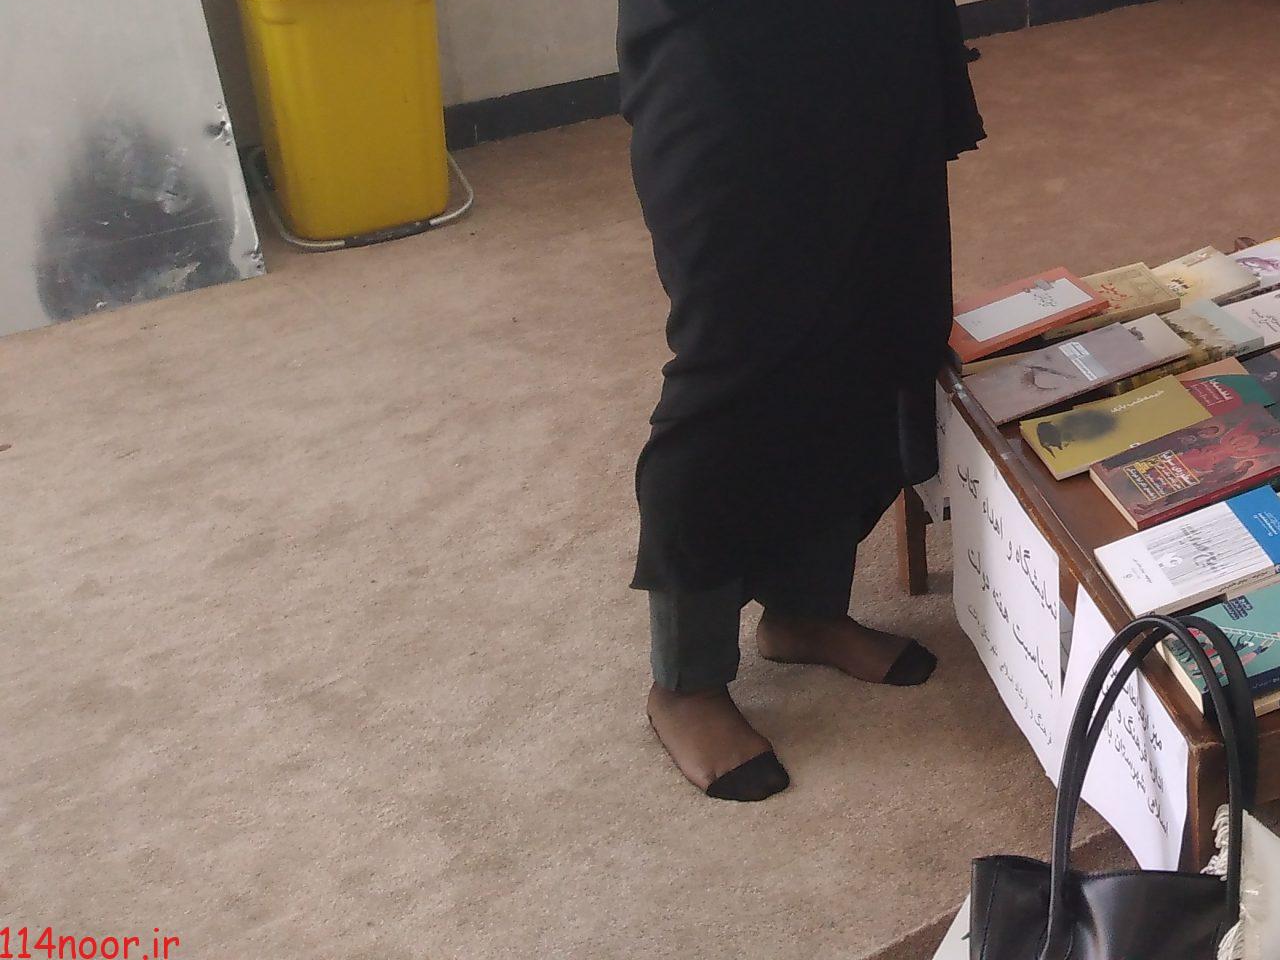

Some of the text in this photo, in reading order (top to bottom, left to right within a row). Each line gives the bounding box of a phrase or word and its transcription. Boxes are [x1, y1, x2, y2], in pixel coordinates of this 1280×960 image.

[957, 464, 980, 499] کتاب
[1006, 540, 1013, 561] و
[1016, 545, 1057, 620] نمایشگاه
